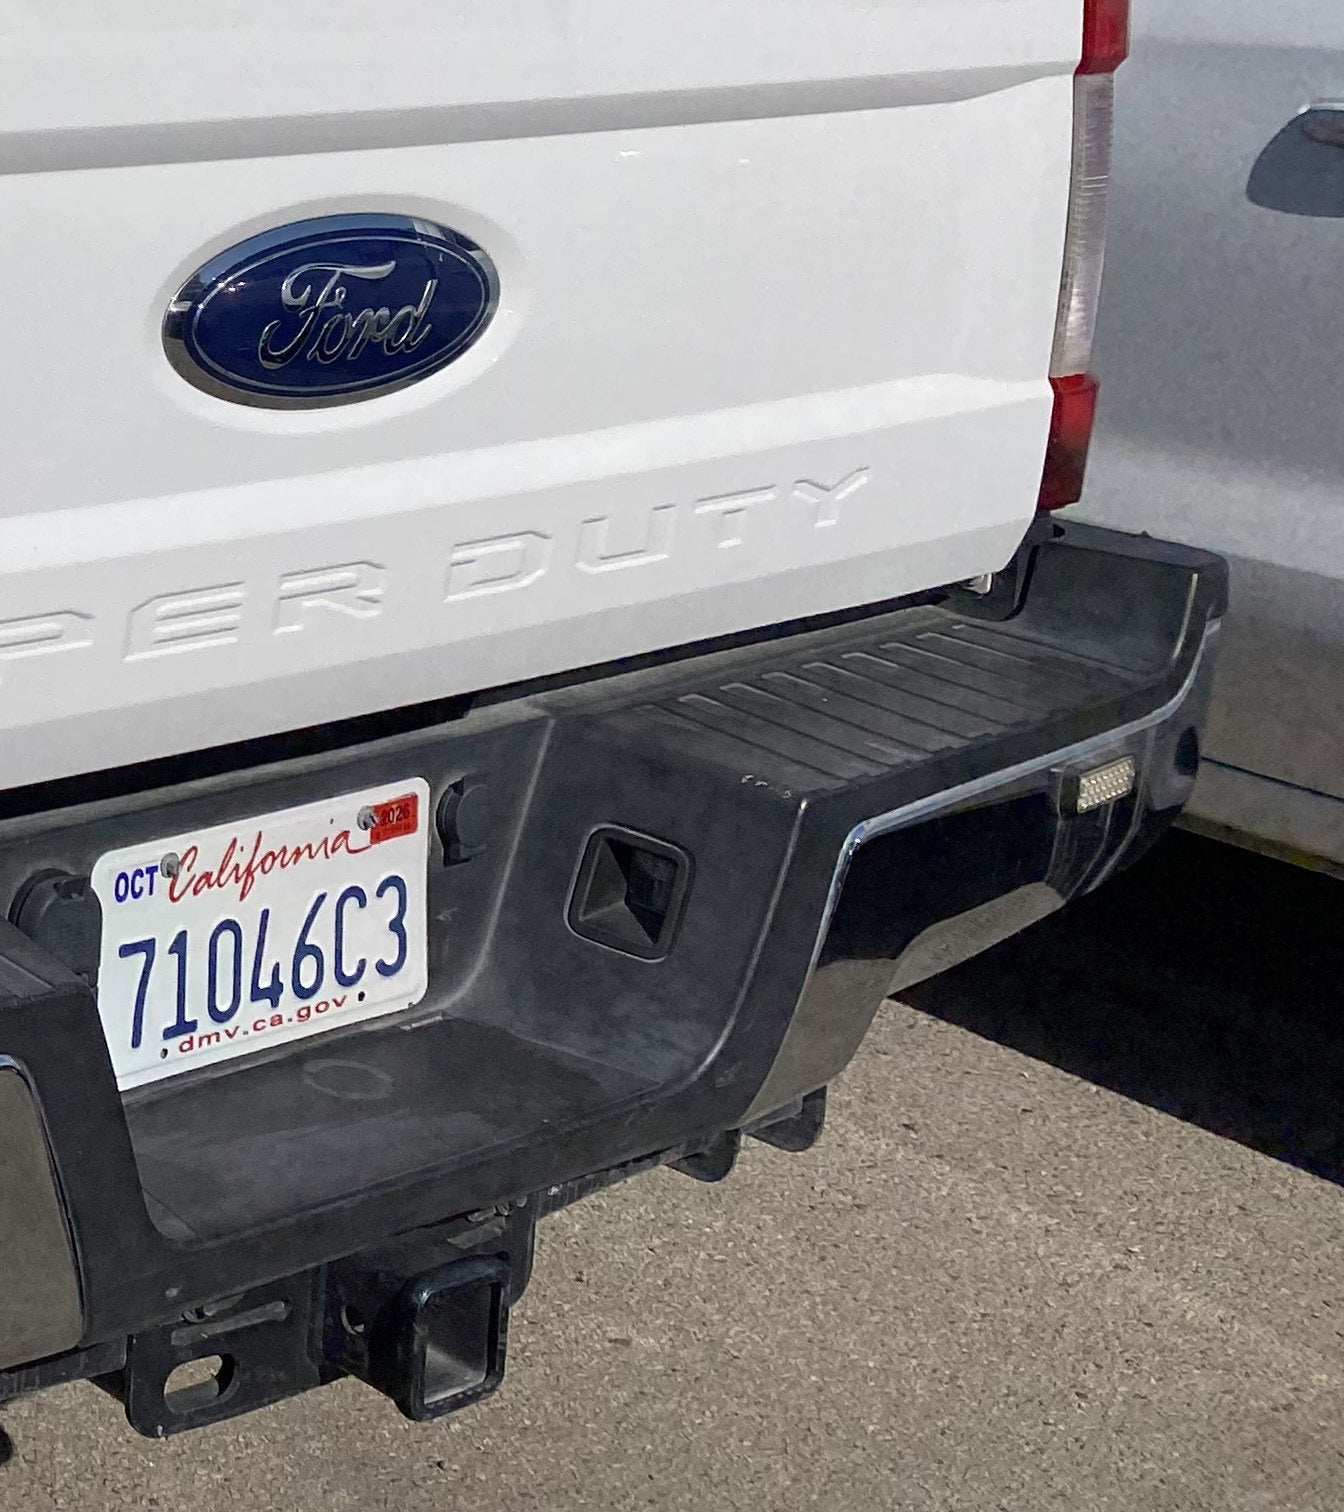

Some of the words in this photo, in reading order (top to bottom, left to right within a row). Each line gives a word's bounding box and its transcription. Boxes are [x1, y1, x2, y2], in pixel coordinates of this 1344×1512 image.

[259, 259, 440, 369] Ford
[443, 465, 871, 604] DUTY
[114, 864, 159, 903] OCT
[167, 830, 370, 904] California
[118, 874, 408, 1049] 71046C3
[178, 994, 348, 1054] dmv.ca.gov
